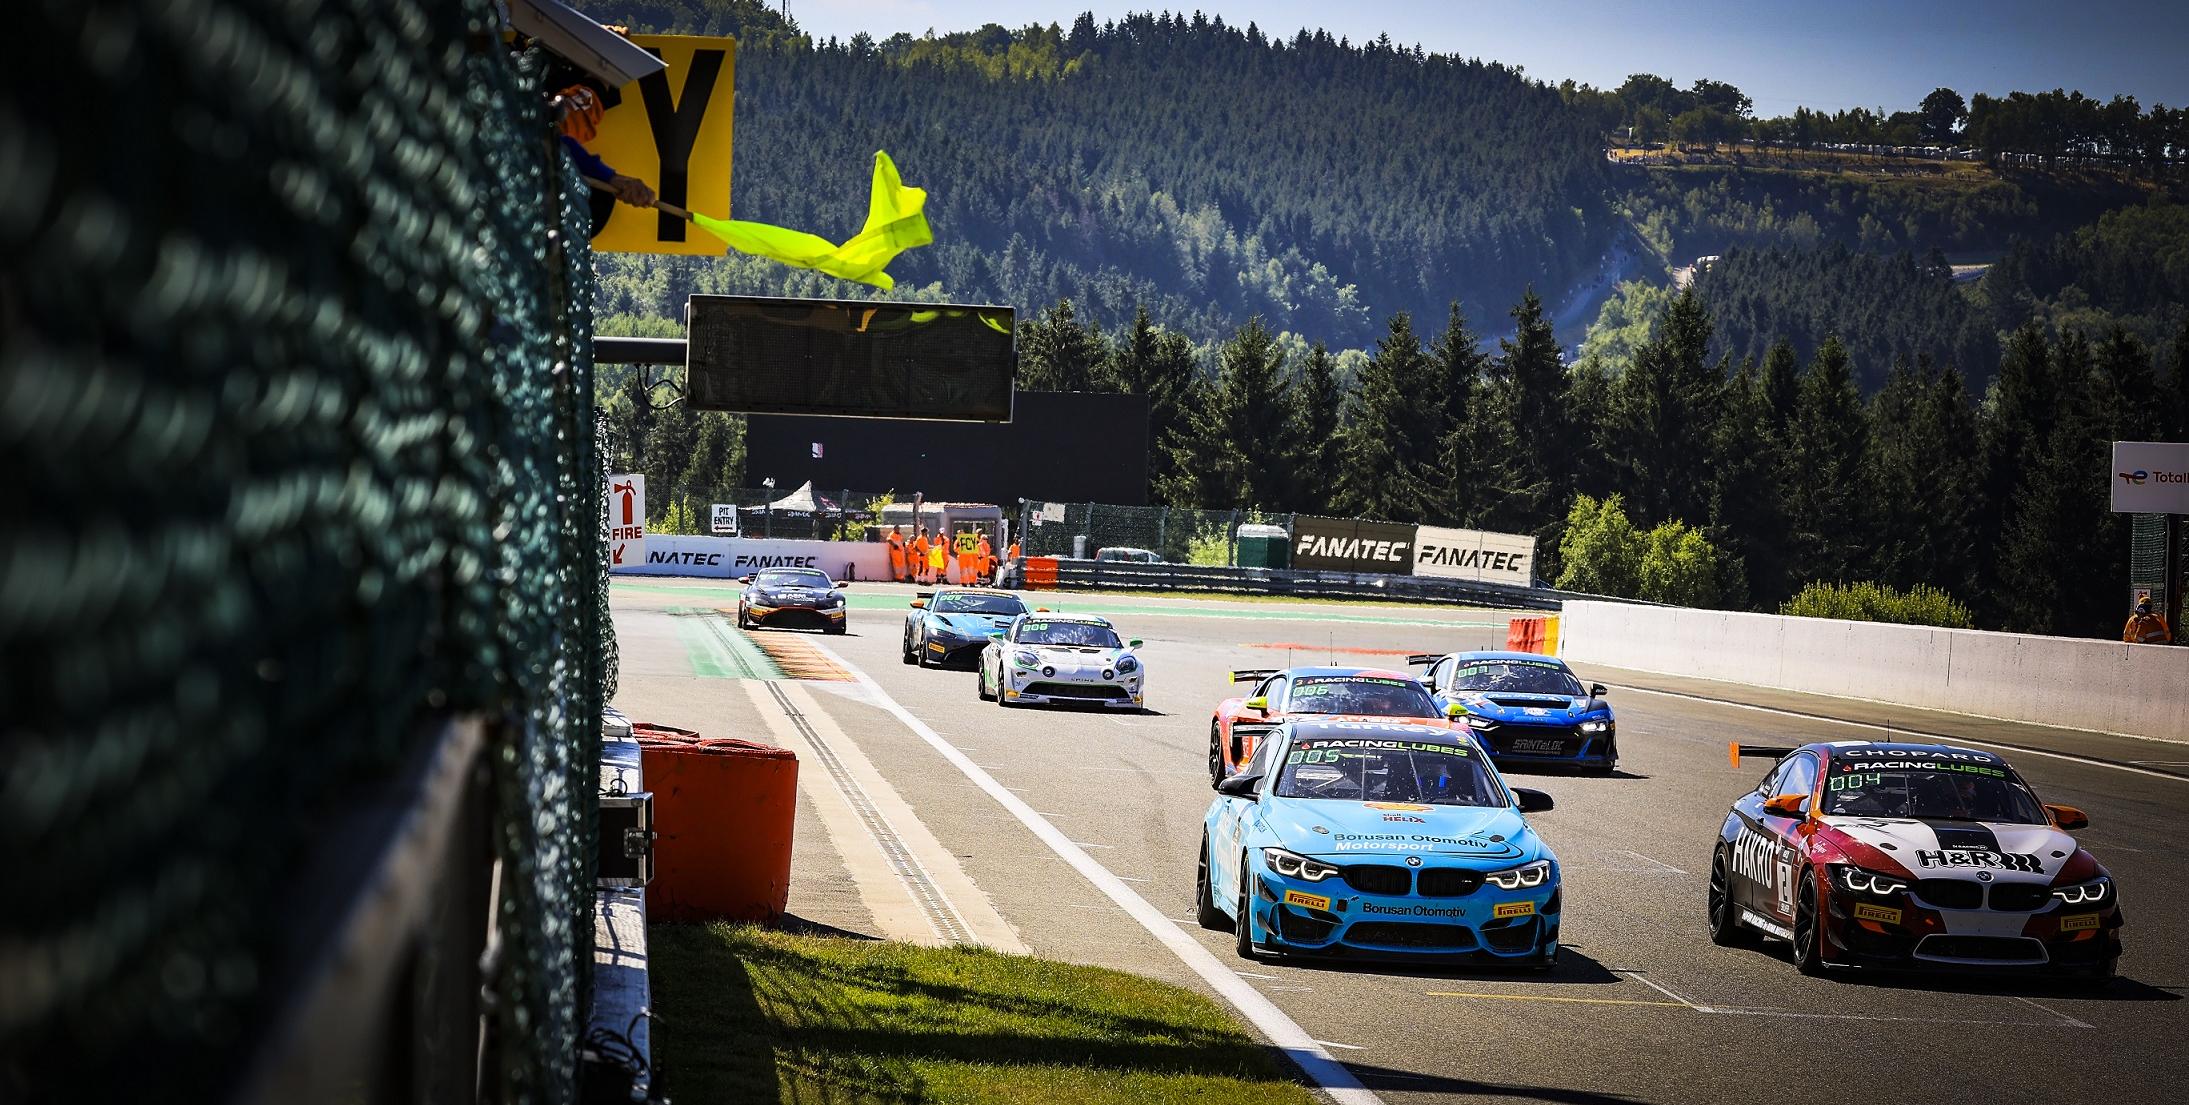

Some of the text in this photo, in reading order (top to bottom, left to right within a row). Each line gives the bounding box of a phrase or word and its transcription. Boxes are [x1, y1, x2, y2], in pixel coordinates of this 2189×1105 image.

[606, 48, 726, 242] Y
[2152, 471, 2189, 484] Total
[718, 507, 730, 516] PIT
[713, 516, 734, 526] ENTRY
[612, 526, 642, 540] FIRE
[960, 536, 976, 552] FCY
[1297, 534, 1405, 562] FANATEC
[645, 551, 722, 566] NATEC
[735, 556, 816, 568] FANATEC
[1419, 546, 1524, 572] FANATEC
[1471, 659, 1560, 670] RACINGLUBES
[1314, 677, 1406, 688] RACINGLUBES
[1293, 685, 1329, 697] 006
[1313, 740, 1468, 757] RACINGLUBES
[1287, 749, 1341, 765] 005
[1845, 750, 1992, 763] CHOPARD
[1854, 761, 2005, 777] RACINGLUBES
[1830, 772, 1881, 791] 004
[1383, 816, 1426, 824] HELIX
[1334, 833, 1488, 849] Borusan Otomotiv
[1335, 842, 1434, 852] Motorsport
[1732, 826, 1775, 889] HAKRO
[1916, 850, 2001, 869] H&R
[1780, 864, 1789, 903] 2
[1288, 892, 1326, 909] PIRELLI
[1363, 902, 1467, 917] Borusan Otomotiv
[1497, 903, 1532, 916] PIRELLI
[1859, 905, 1898, 921] PIRELLI
[2064, 916, 2097, 929] PIRELLI
